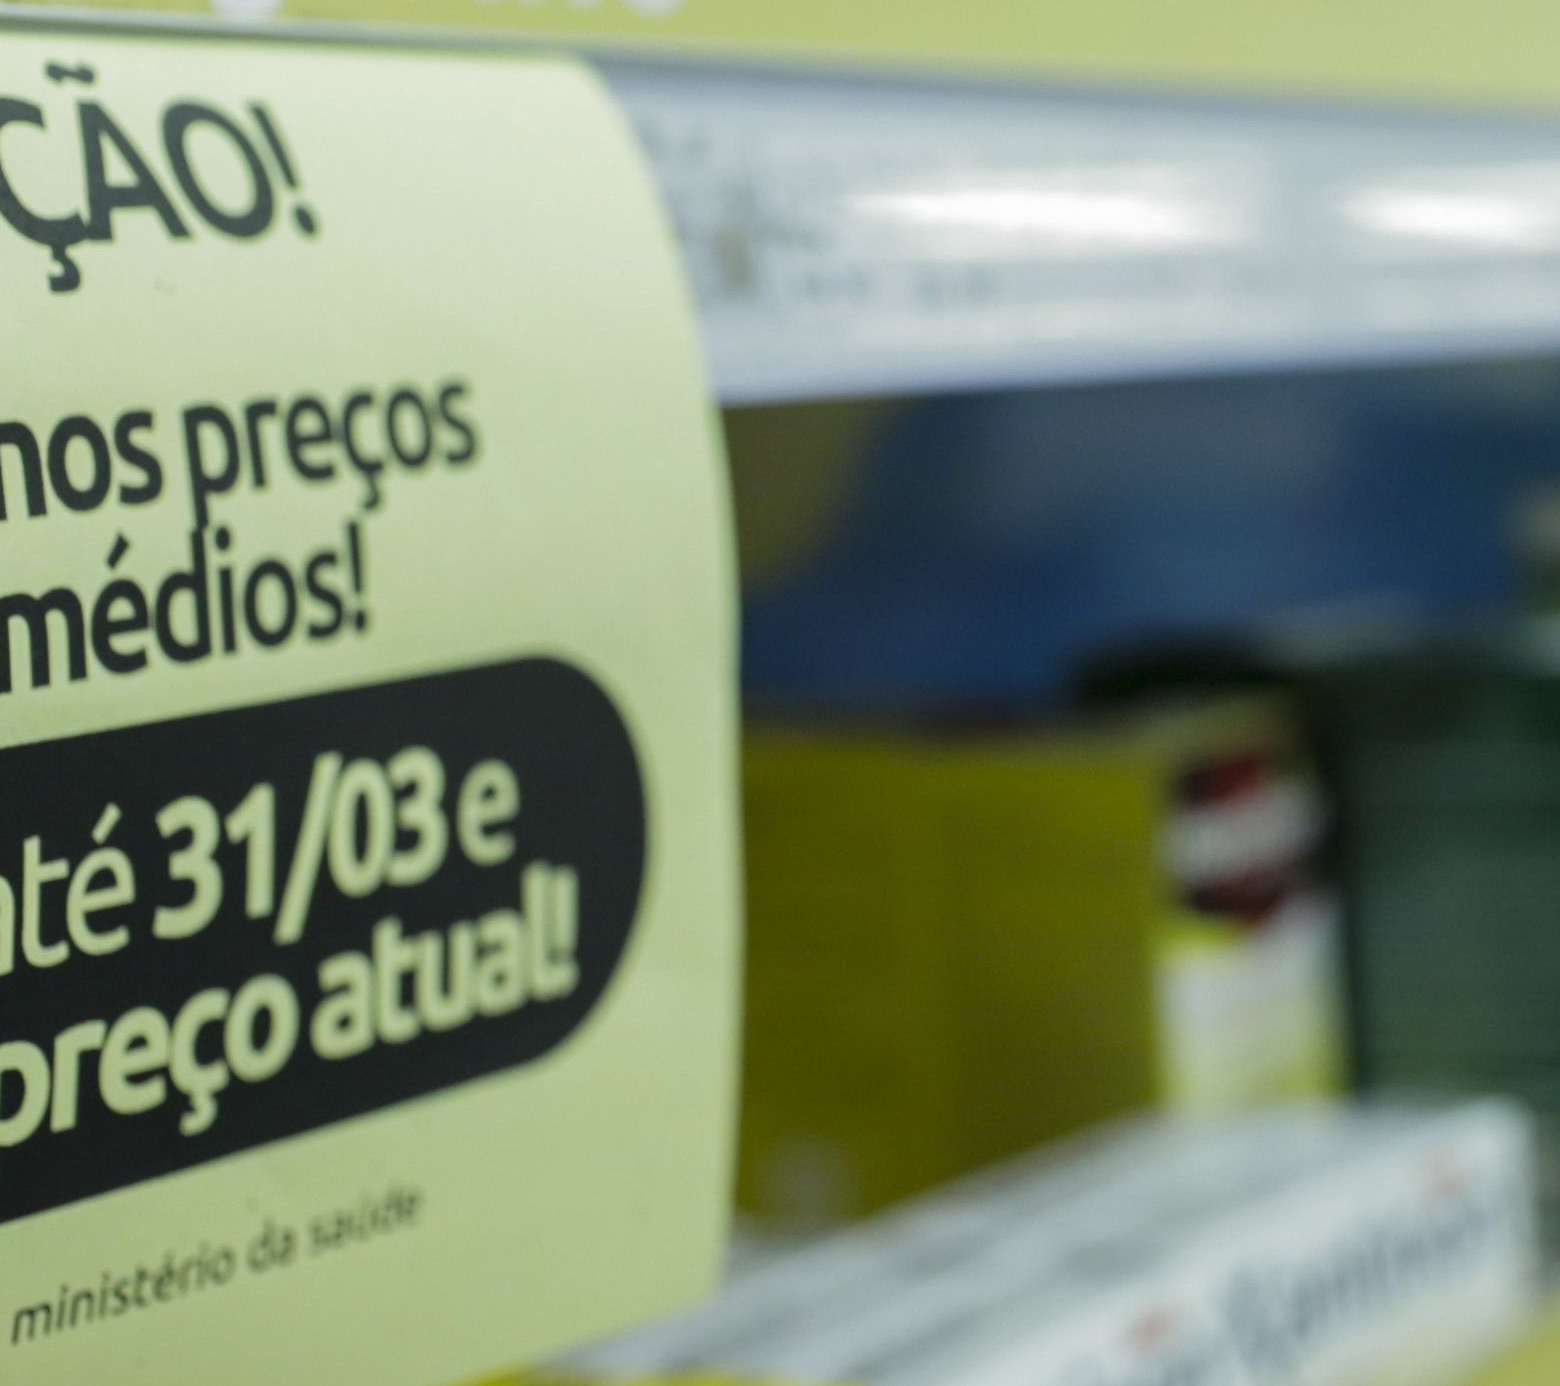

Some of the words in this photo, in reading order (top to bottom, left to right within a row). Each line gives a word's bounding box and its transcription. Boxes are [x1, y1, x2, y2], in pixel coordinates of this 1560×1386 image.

[183, 376, 483, 537] preços
[152, 746, 444, 946] 31/03
[457, 755, 519, 847] e
[310, 865, 580, 1063] atual!
[11, 1248, 237, 1348] ministério
[246, 1217, 301, 1272] da
[309, 1182, 424, 1254] saúde
